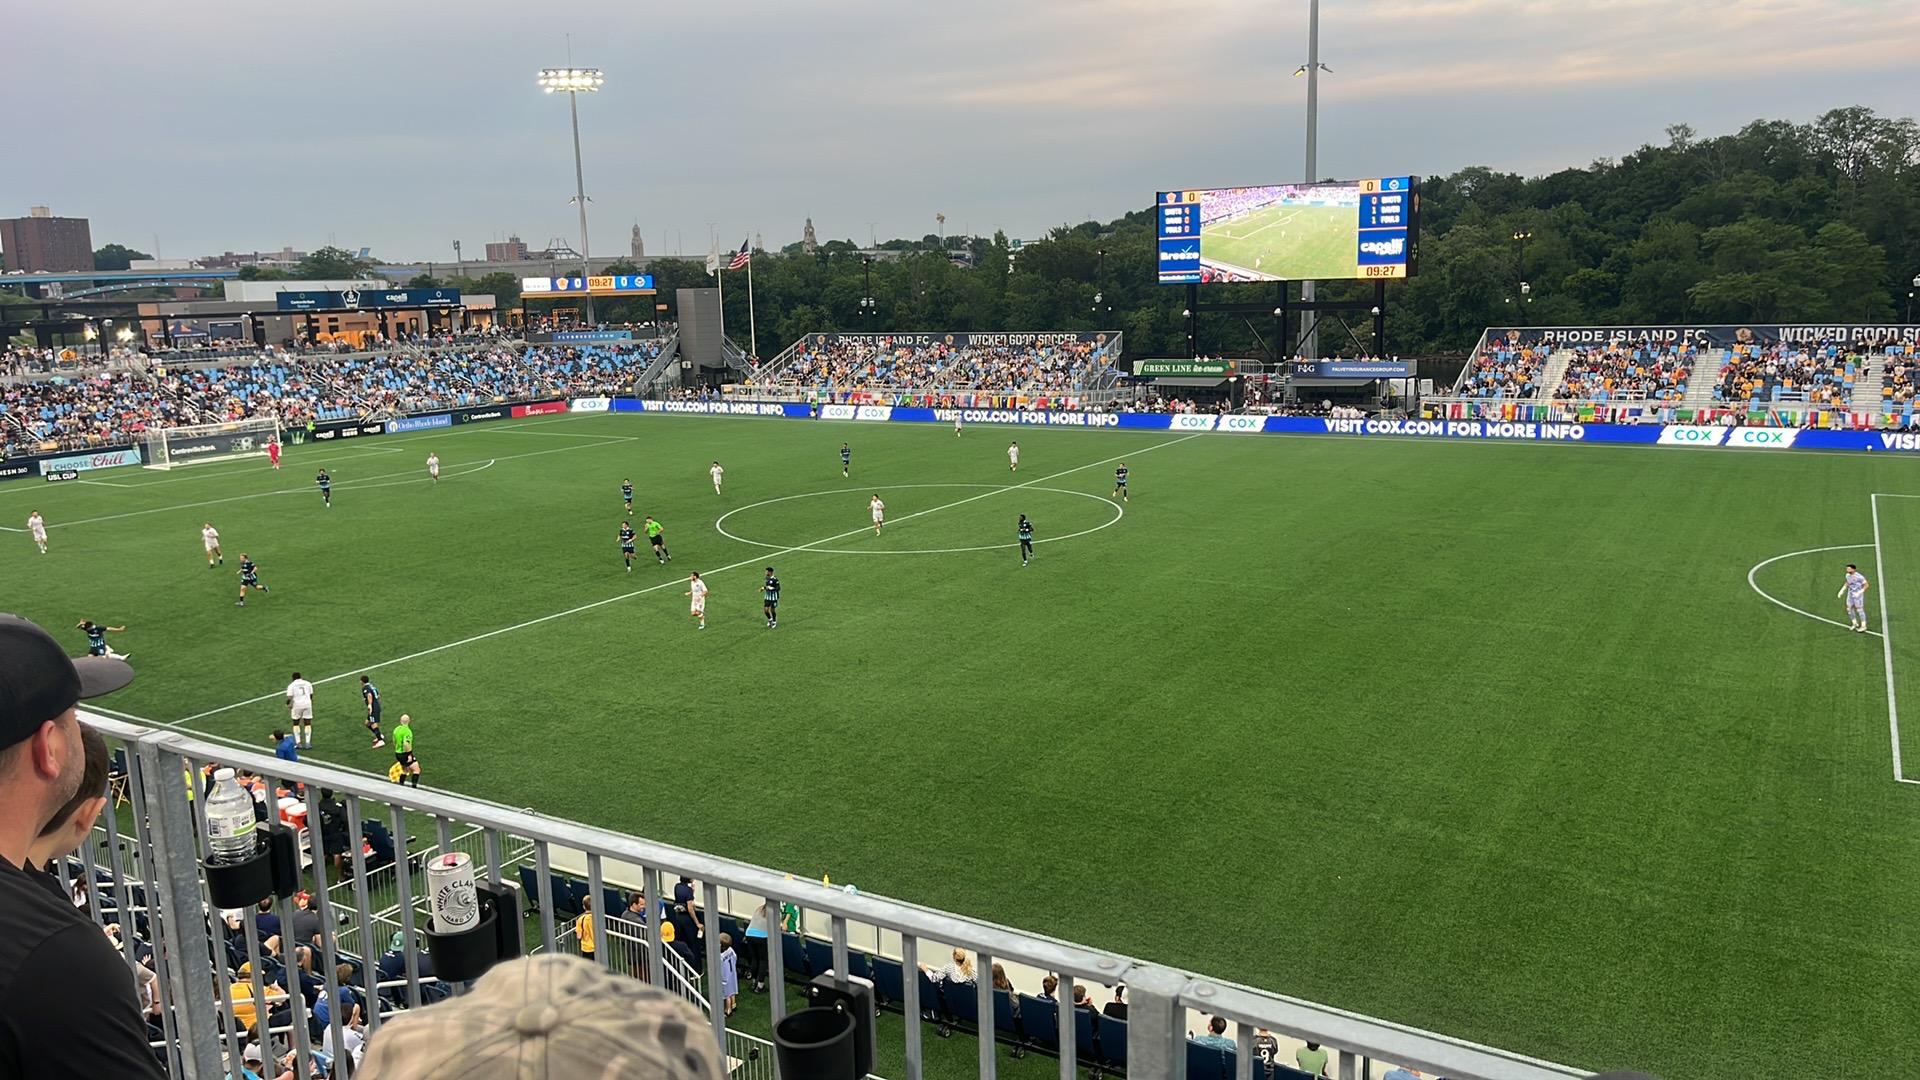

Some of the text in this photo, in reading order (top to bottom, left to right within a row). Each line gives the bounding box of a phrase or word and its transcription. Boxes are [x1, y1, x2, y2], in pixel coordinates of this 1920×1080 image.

[1367, 182, 1374, 191] 0
[1189, 193, 1195, 202] 0
[1366, 266, 1395, 276] 09:27
[574, 277, 628, 288] 0 09:27 0
[839, 336, 873, 344] RHODE
[916, 336, 929, 344] FC
[968, 335, 1007, 345] WICKED
[1009, 334, 1035, 345] GOOD
[1544, 330, 1706, 342] RHODE ISLAND FC
[1779, 328, 1847, 342] WICKED
[1852, 327, 1899, 341] GOOD
[581, 400, 604, 408] COX
[642, 401, 665, 411] VISIT
[665, 401, 707, 412] COX.COM
[710, 403, 728, 413] FOR
[731, 403, 758, 414] MORE
[829, 407, 849, 416] COX
[865, 409, 885, 417] COX
[964, 412, 1019, 423] COX.COM
[1022, 413, 1046, 424] FOR
[1050, 413, 1084, 425] MORE
[1088, 414, 1119, 426] INFO
[1181, 417, 1207, 426] COX
[1229, 418, 1256, 428] COX
[1324, 419, 1585, 439] VISIT COX.COM FOR MORE INFO
[1674, 429, 1711, 441] COX
[1744, 431, 1782, 443] COX
[55, 453, 125, 471] CHOOSE Chill
[63, 472, 77, 480] CUP
[437, 886, 451, 911] WHITE
[1261, 1049, 1270, 1064] 9
